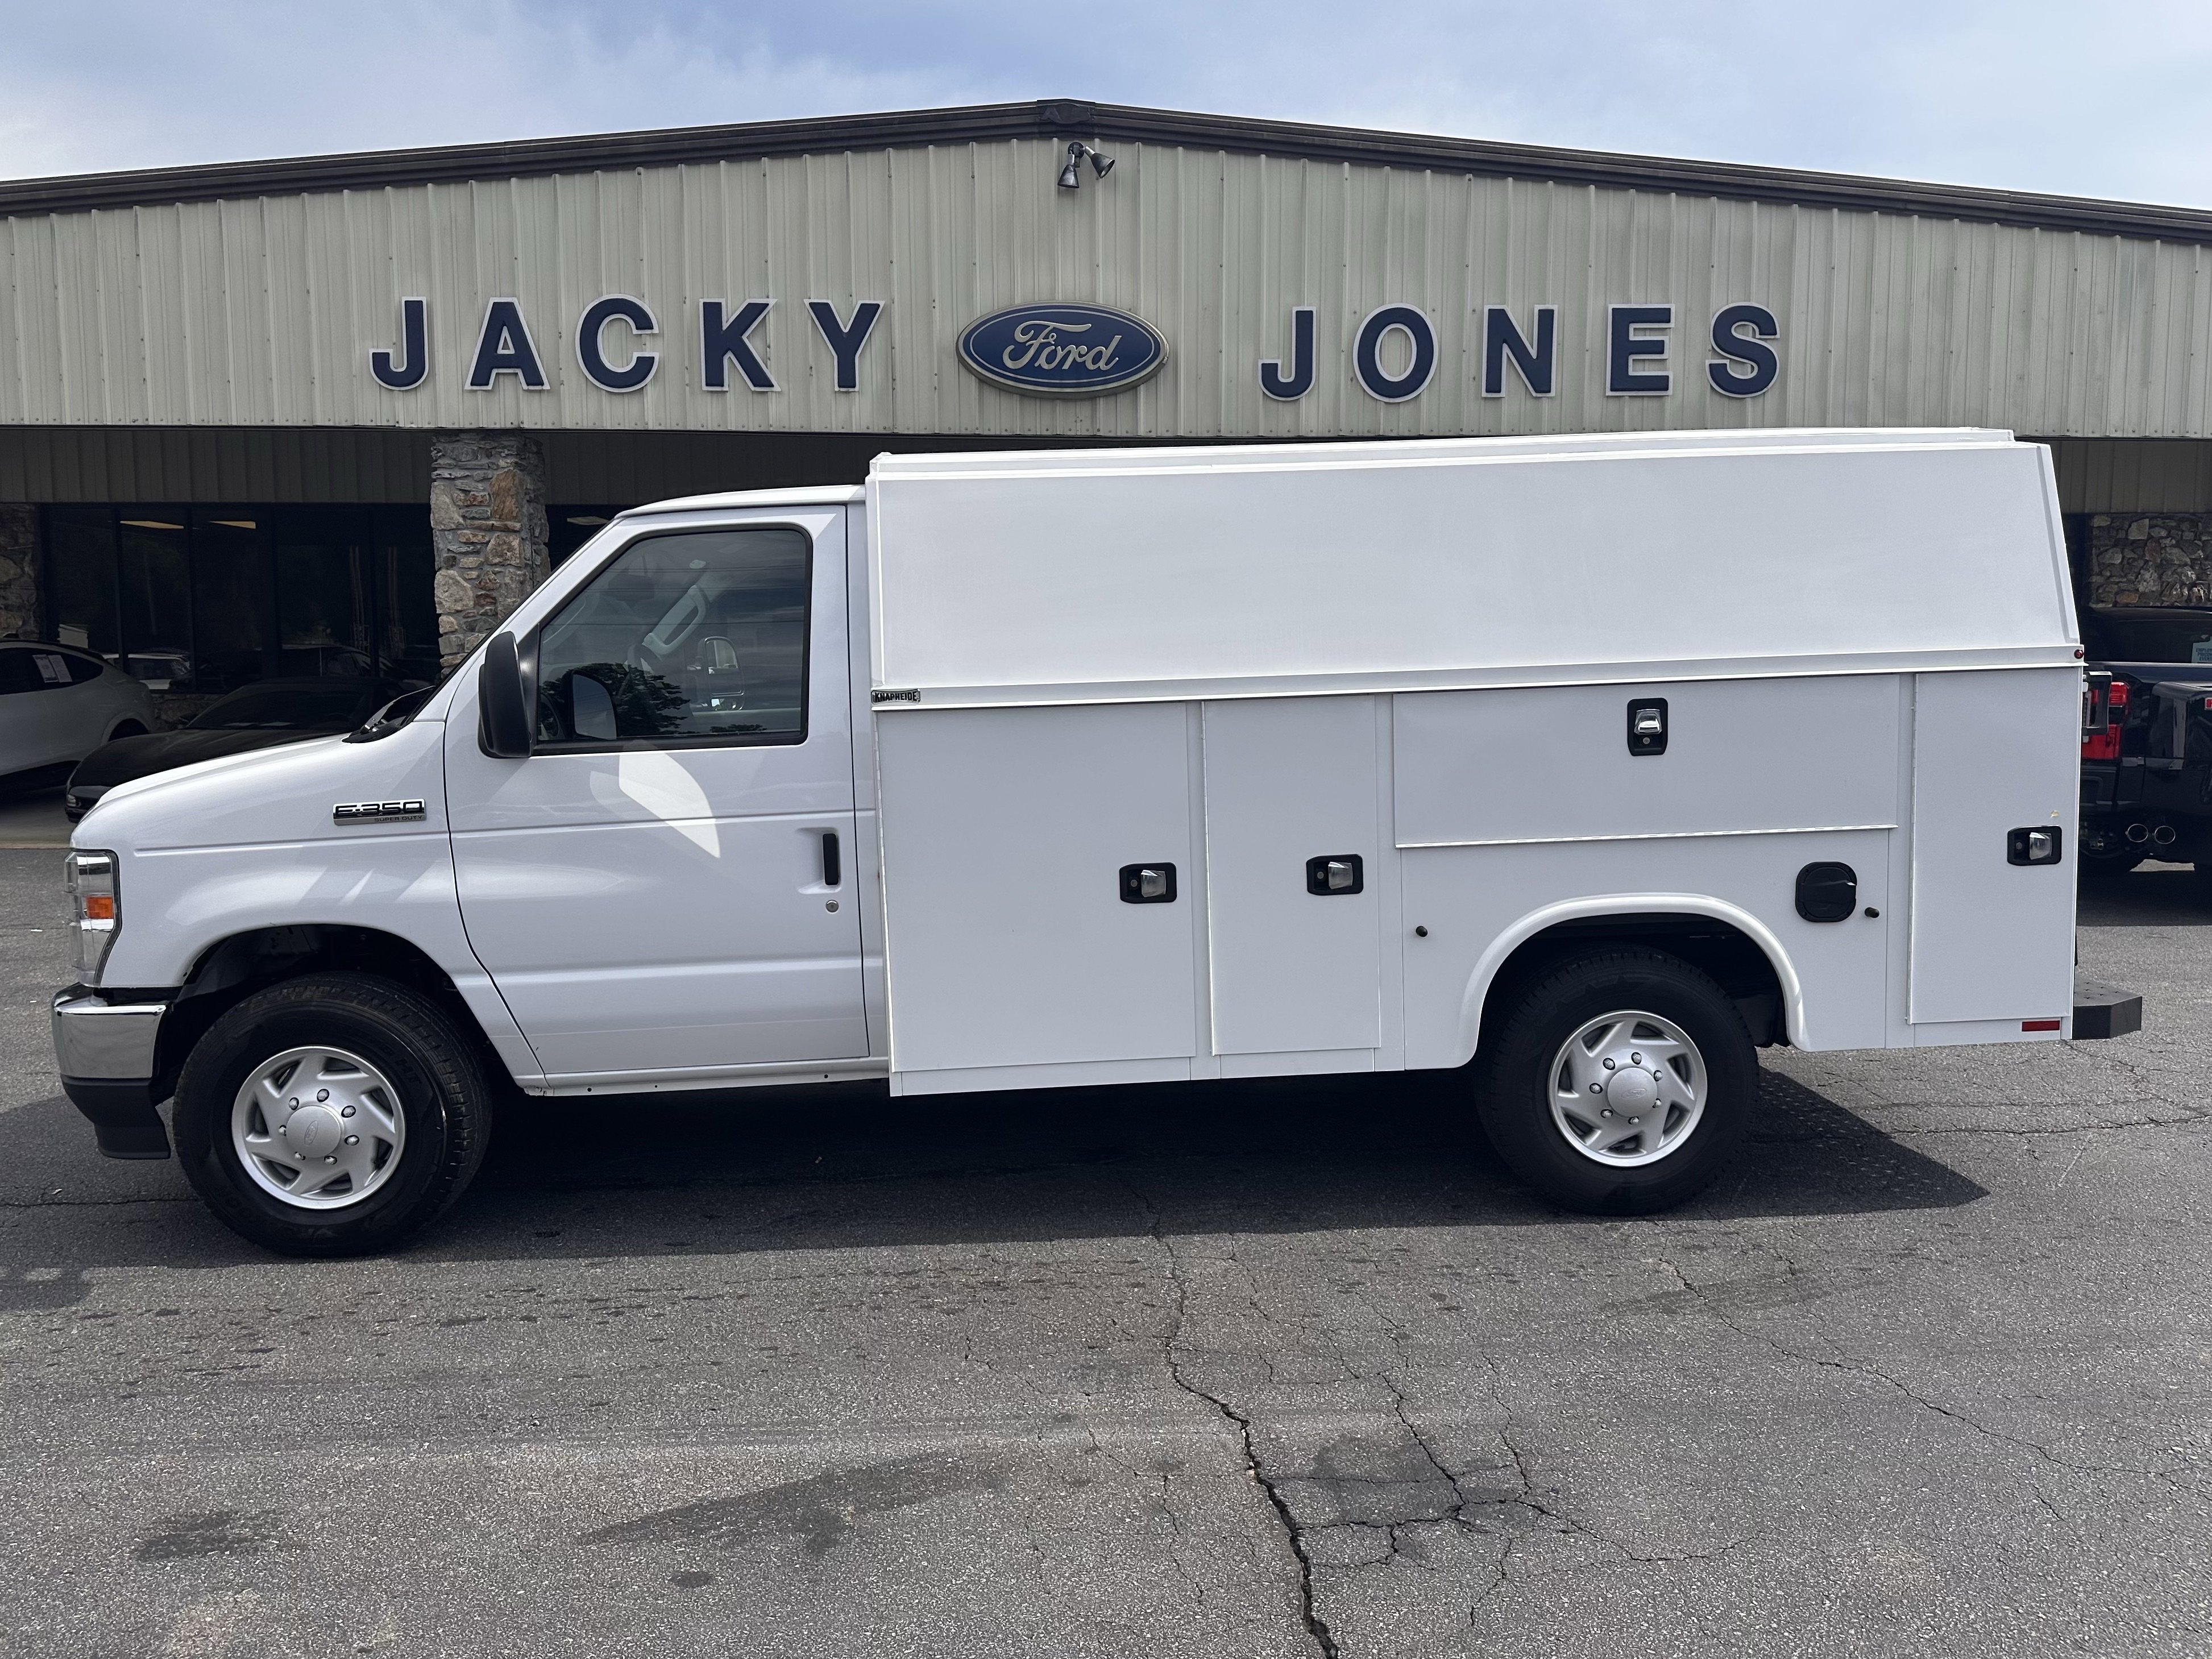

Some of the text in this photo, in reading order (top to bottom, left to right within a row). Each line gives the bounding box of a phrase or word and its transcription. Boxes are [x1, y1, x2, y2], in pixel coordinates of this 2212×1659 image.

[370, 295, 1781, 401] JACKY Ford JONES
[875, 691, 917, 703] KNAPHEIDE
